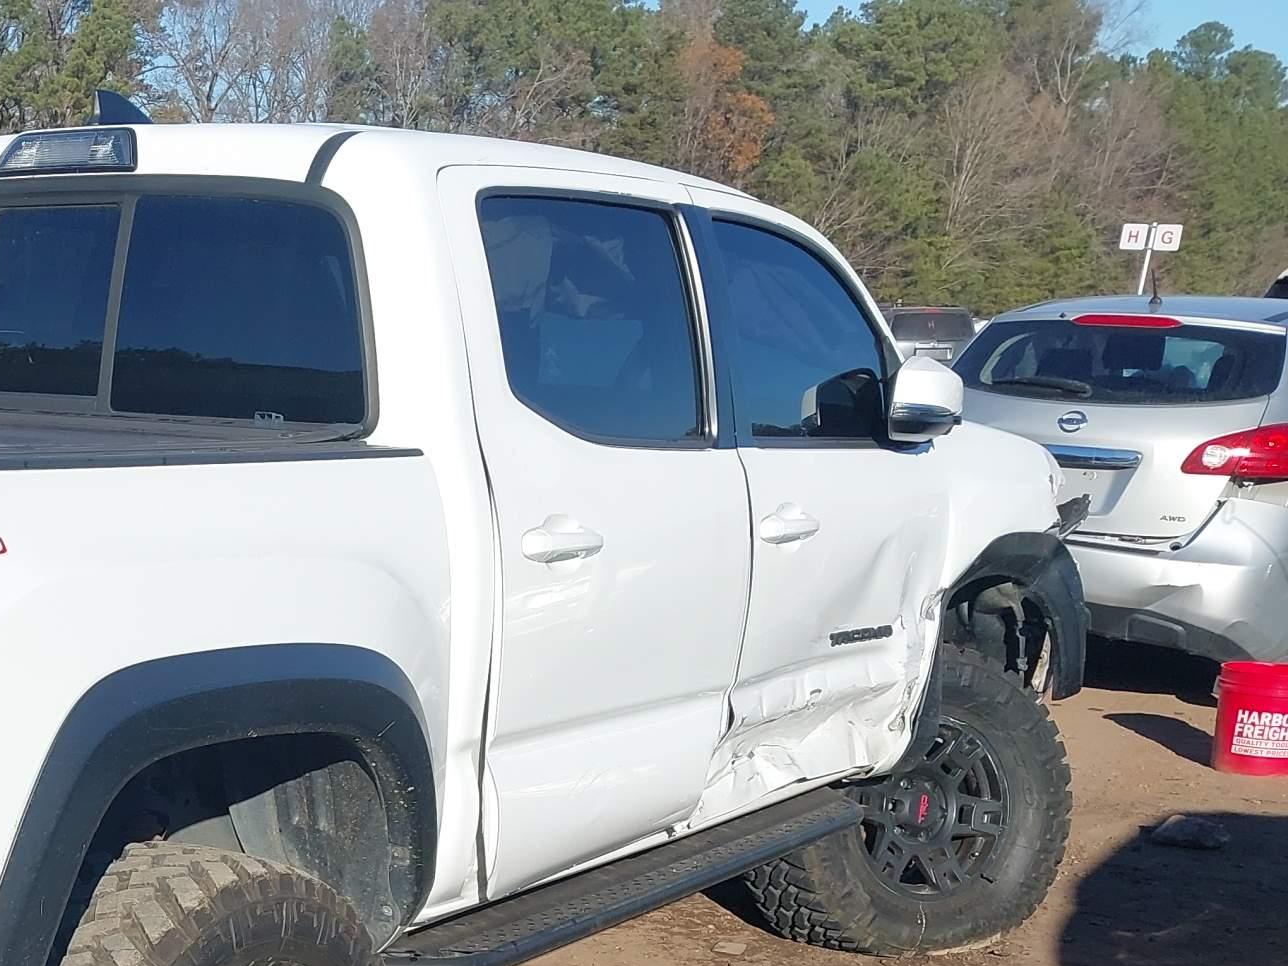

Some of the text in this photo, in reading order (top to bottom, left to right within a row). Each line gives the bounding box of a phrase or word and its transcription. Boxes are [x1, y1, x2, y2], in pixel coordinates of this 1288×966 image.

[1127, 230, 1140, 243] H
[1161, 230, 1174, 245] G
[1236, 738, 1269, 747] QUALITY
[918, 795, 928, 823] TRD
